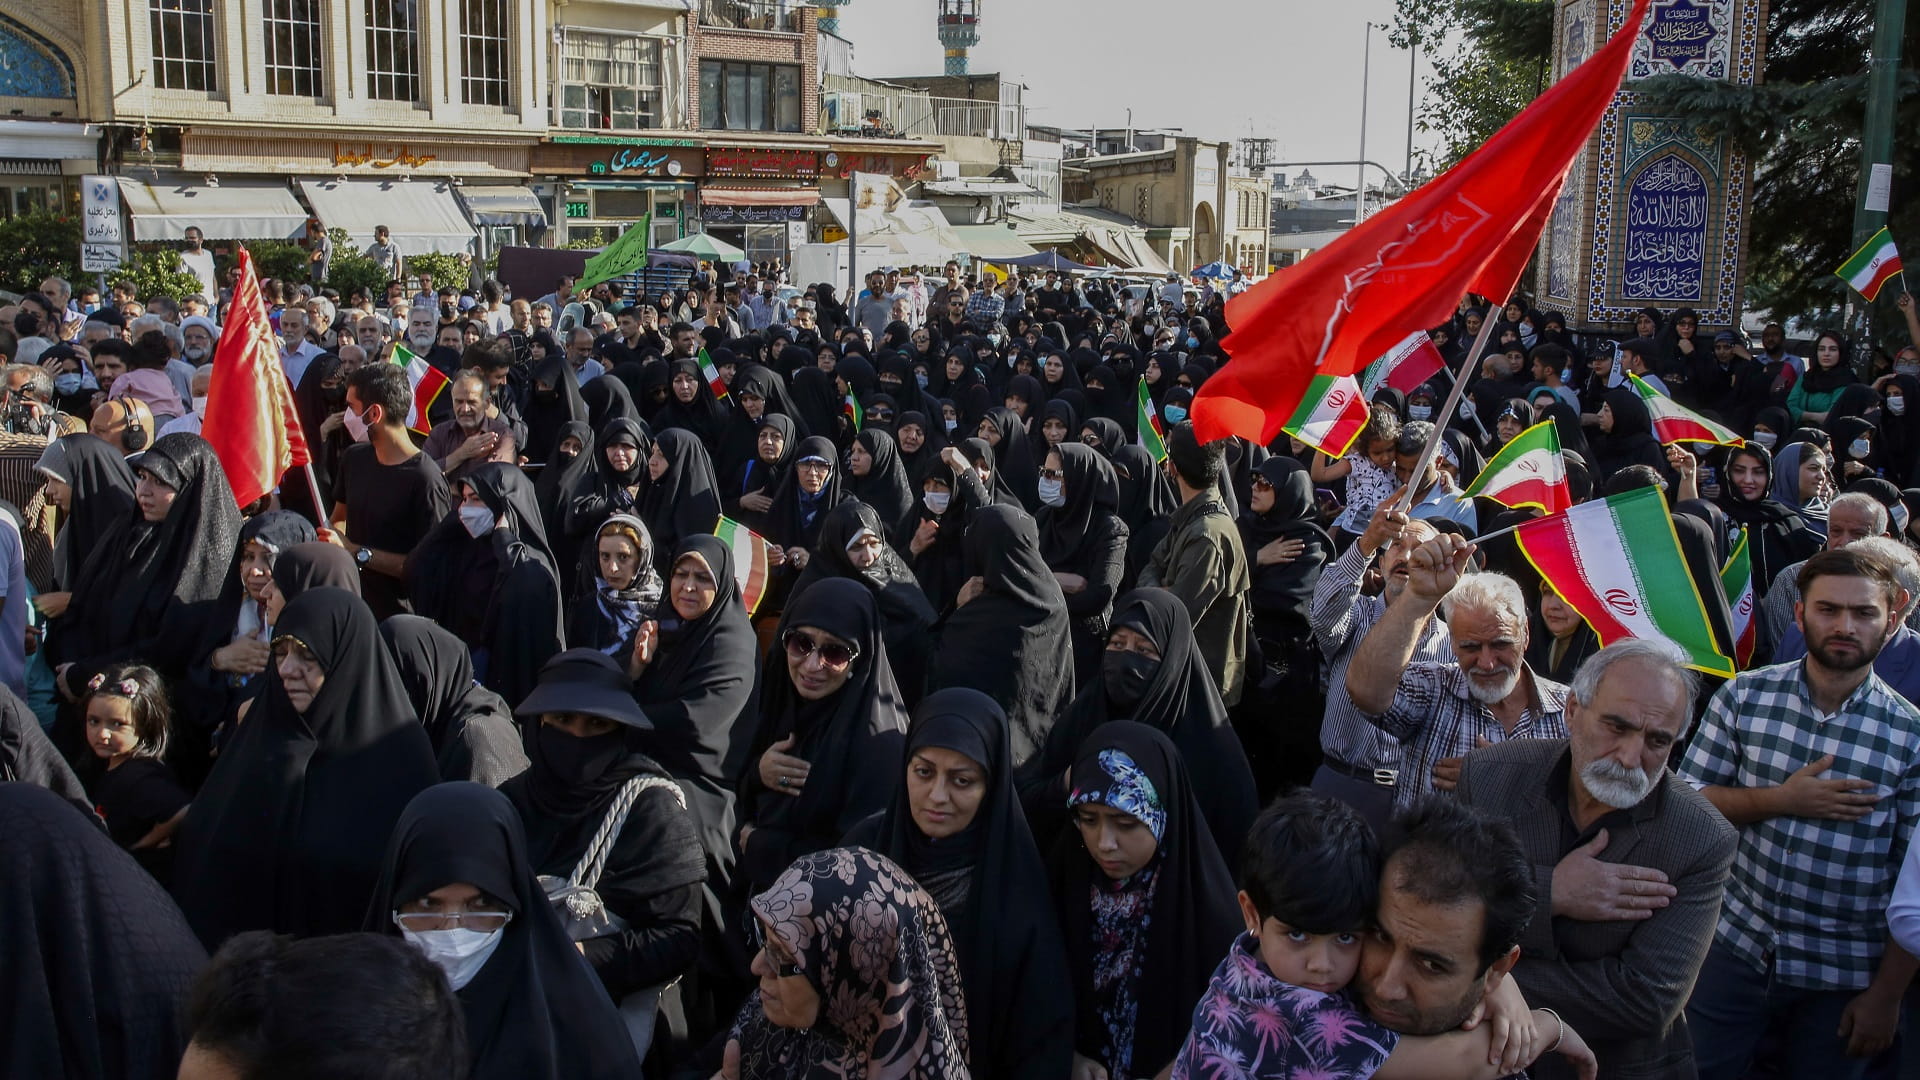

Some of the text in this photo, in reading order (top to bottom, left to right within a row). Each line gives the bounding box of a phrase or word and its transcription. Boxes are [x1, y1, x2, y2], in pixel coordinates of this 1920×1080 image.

[610, 148, 669, 174] سید مهدی
[87, 206, 117, 219] محل تخلیه
